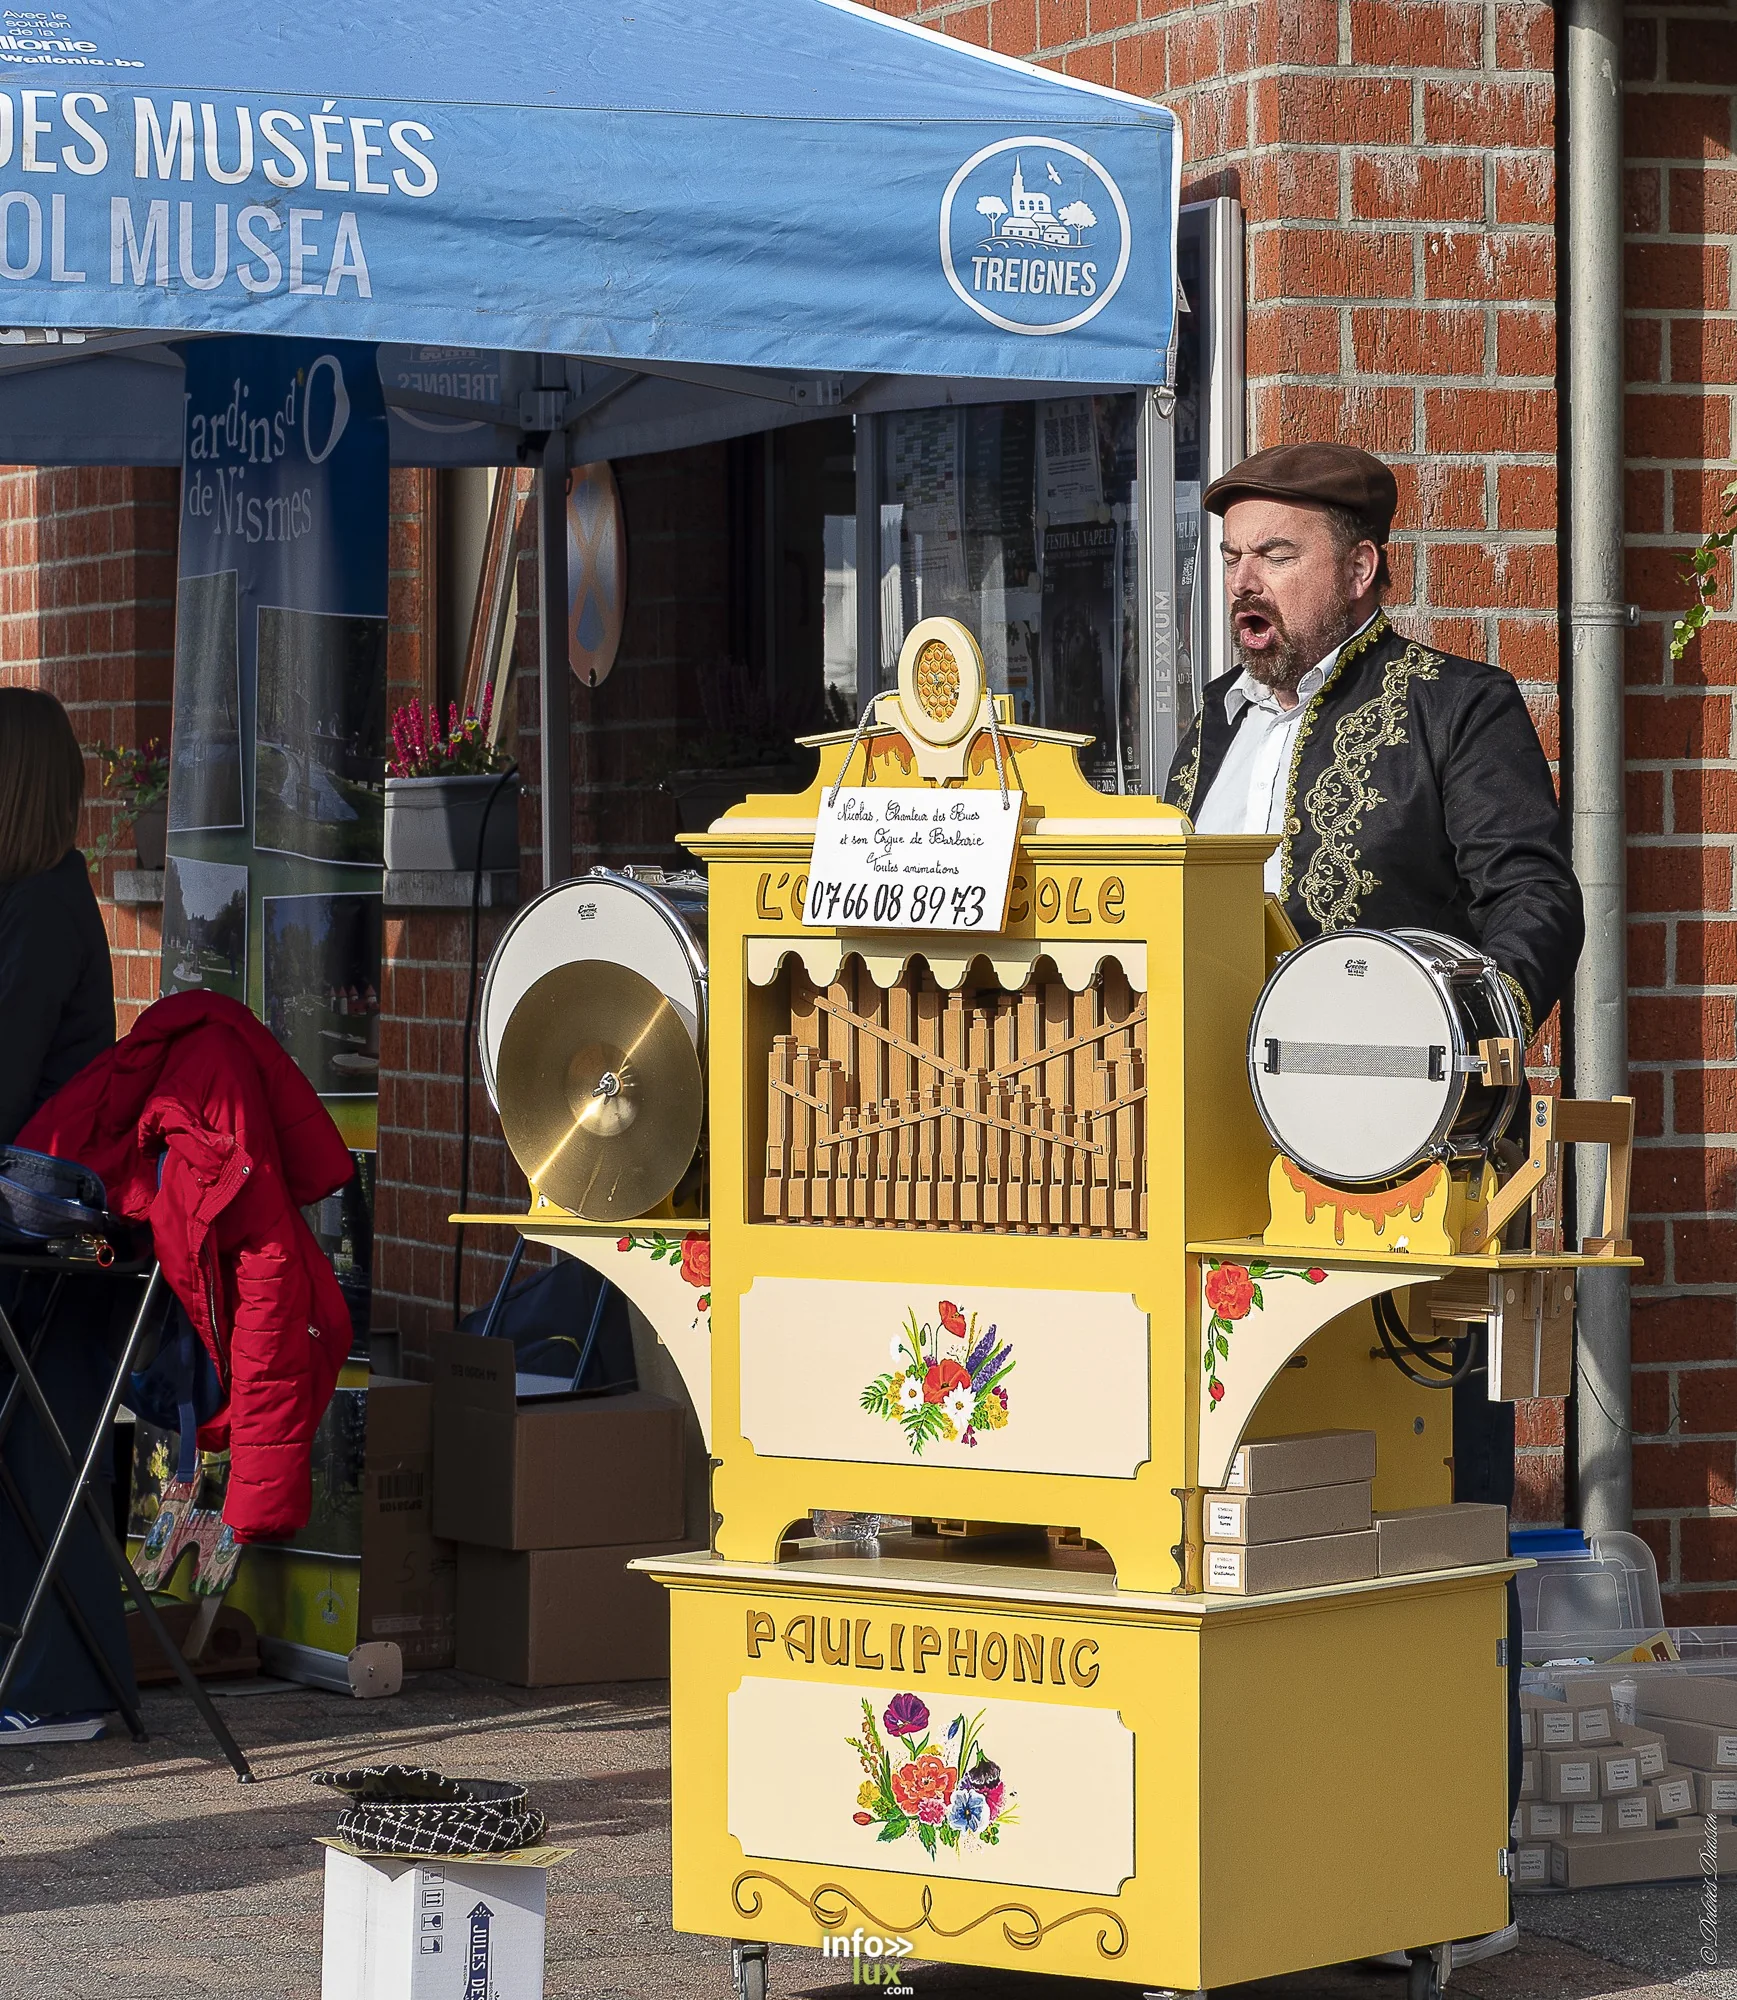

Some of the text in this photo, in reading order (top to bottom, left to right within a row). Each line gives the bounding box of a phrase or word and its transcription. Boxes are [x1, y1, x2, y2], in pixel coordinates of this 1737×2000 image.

[3, 9, 68, 20] Avec le
[5, 20, 72, 29] soutien
[9, 28, 56, 37] de la
[0, 36, 98, 53] llonie
[133, 96, 440, 198] MUSÉES
[109, 196, 373, 299] MUSEA
[970, 256, 1098, 297] TREIGNES
[188, 466, 313, 544] de Nismes
[1155, 591, 1171, 713] FLEXXUM
[885, 799, 929, 822] Chanteur
[932, 808, 946, 821] des
[949, 803, 980, 821] Rues
[840, 827, 985, 853] et son Orgue de Barbarie
[902, 860, 960, 875] animations
[909, 884, 946, 924] 89
[950, 884, 987, 927] 73
[746, 1609, 1100, 1688] PAULIPHONIC
[472, 1925, 487, 1971] JULES
